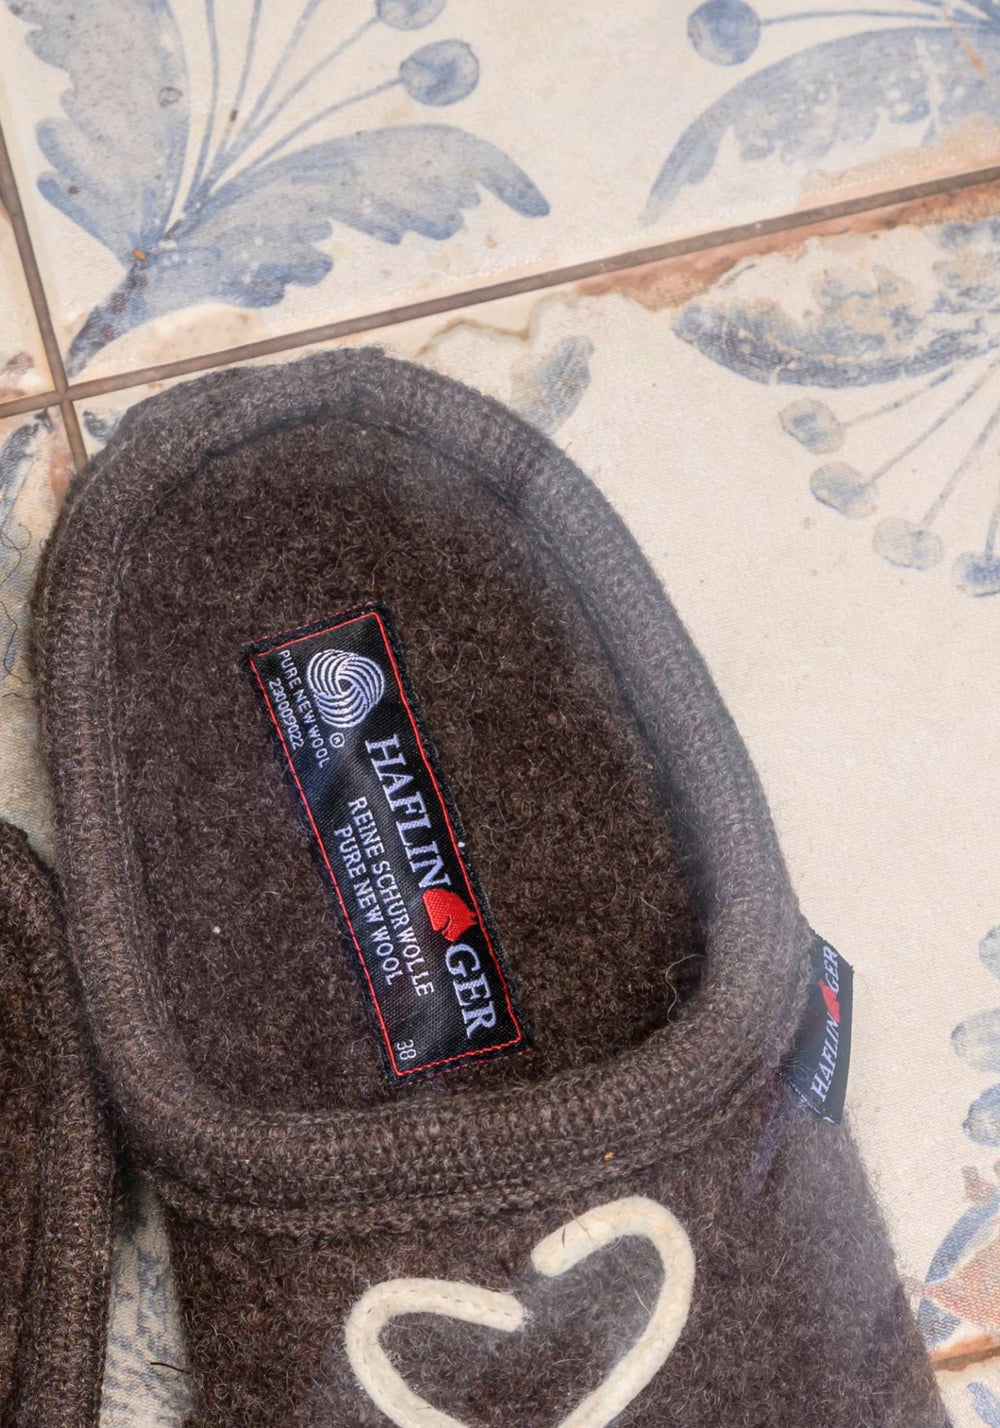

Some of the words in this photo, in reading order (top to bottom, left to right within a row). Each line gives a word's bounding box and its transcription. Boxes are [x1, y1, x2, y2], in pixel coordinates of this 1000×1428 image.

[269, 677, 305, 751] 230009022
[279, 649, 303, 690] PURE
[293, 688, 317, 725] NEW
[308, 724, 331, 769] WOOL
[334, 824, 368, 880] PURE
[353, 878, 385, 924] NEW
[370, 925, 404, 987] WOOL
[348, 796, 386, 860] REINE
[371, 860, 435, 997] SCHURWOLLE
[397, 1037, 417, 1061] 38
